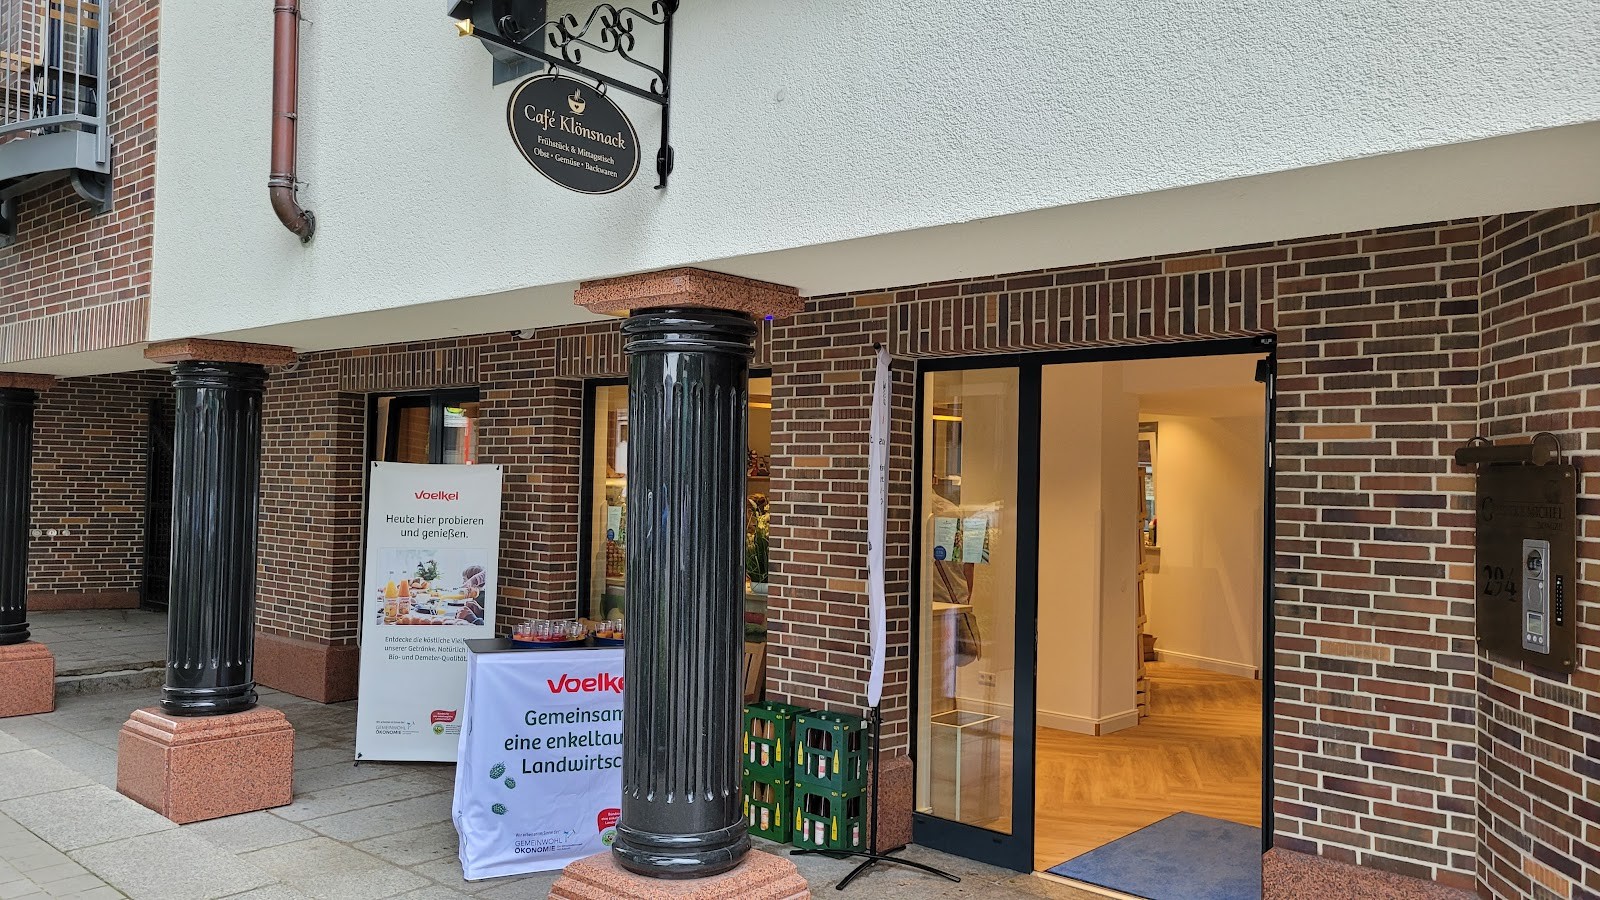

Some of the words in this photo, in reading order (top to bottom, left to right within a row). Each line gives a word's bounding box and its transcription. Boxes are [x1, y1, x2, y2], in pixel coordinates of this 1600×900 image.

[524, 104, 556, 130] Café
[560, 115, 626, 150] Klönsnack
[537, 135, 570, 152] Frühstück
[570, 146, 576, 154] &
[577, 148, 615, 165] Mittagstisch
[533, 147, 550, 159] Obst
[554, 154, 580, 168] Gemüse
[585, 162, 618, 178] Backwaren
[386, 514, 415, 524] Heute
[418, 514, 436, 524] hier
[438, 515, 484, 526] probieren
[401, 528, 419, 537] und
[422, 528, 468, 540] genießen.
[504, 734, 541, 751] eine
[546, 730, 624, 749] enkeltau
[522, 754, 622, 774] Landwirtsc
[514, 838, 562, 846] GEMEINWOHL
